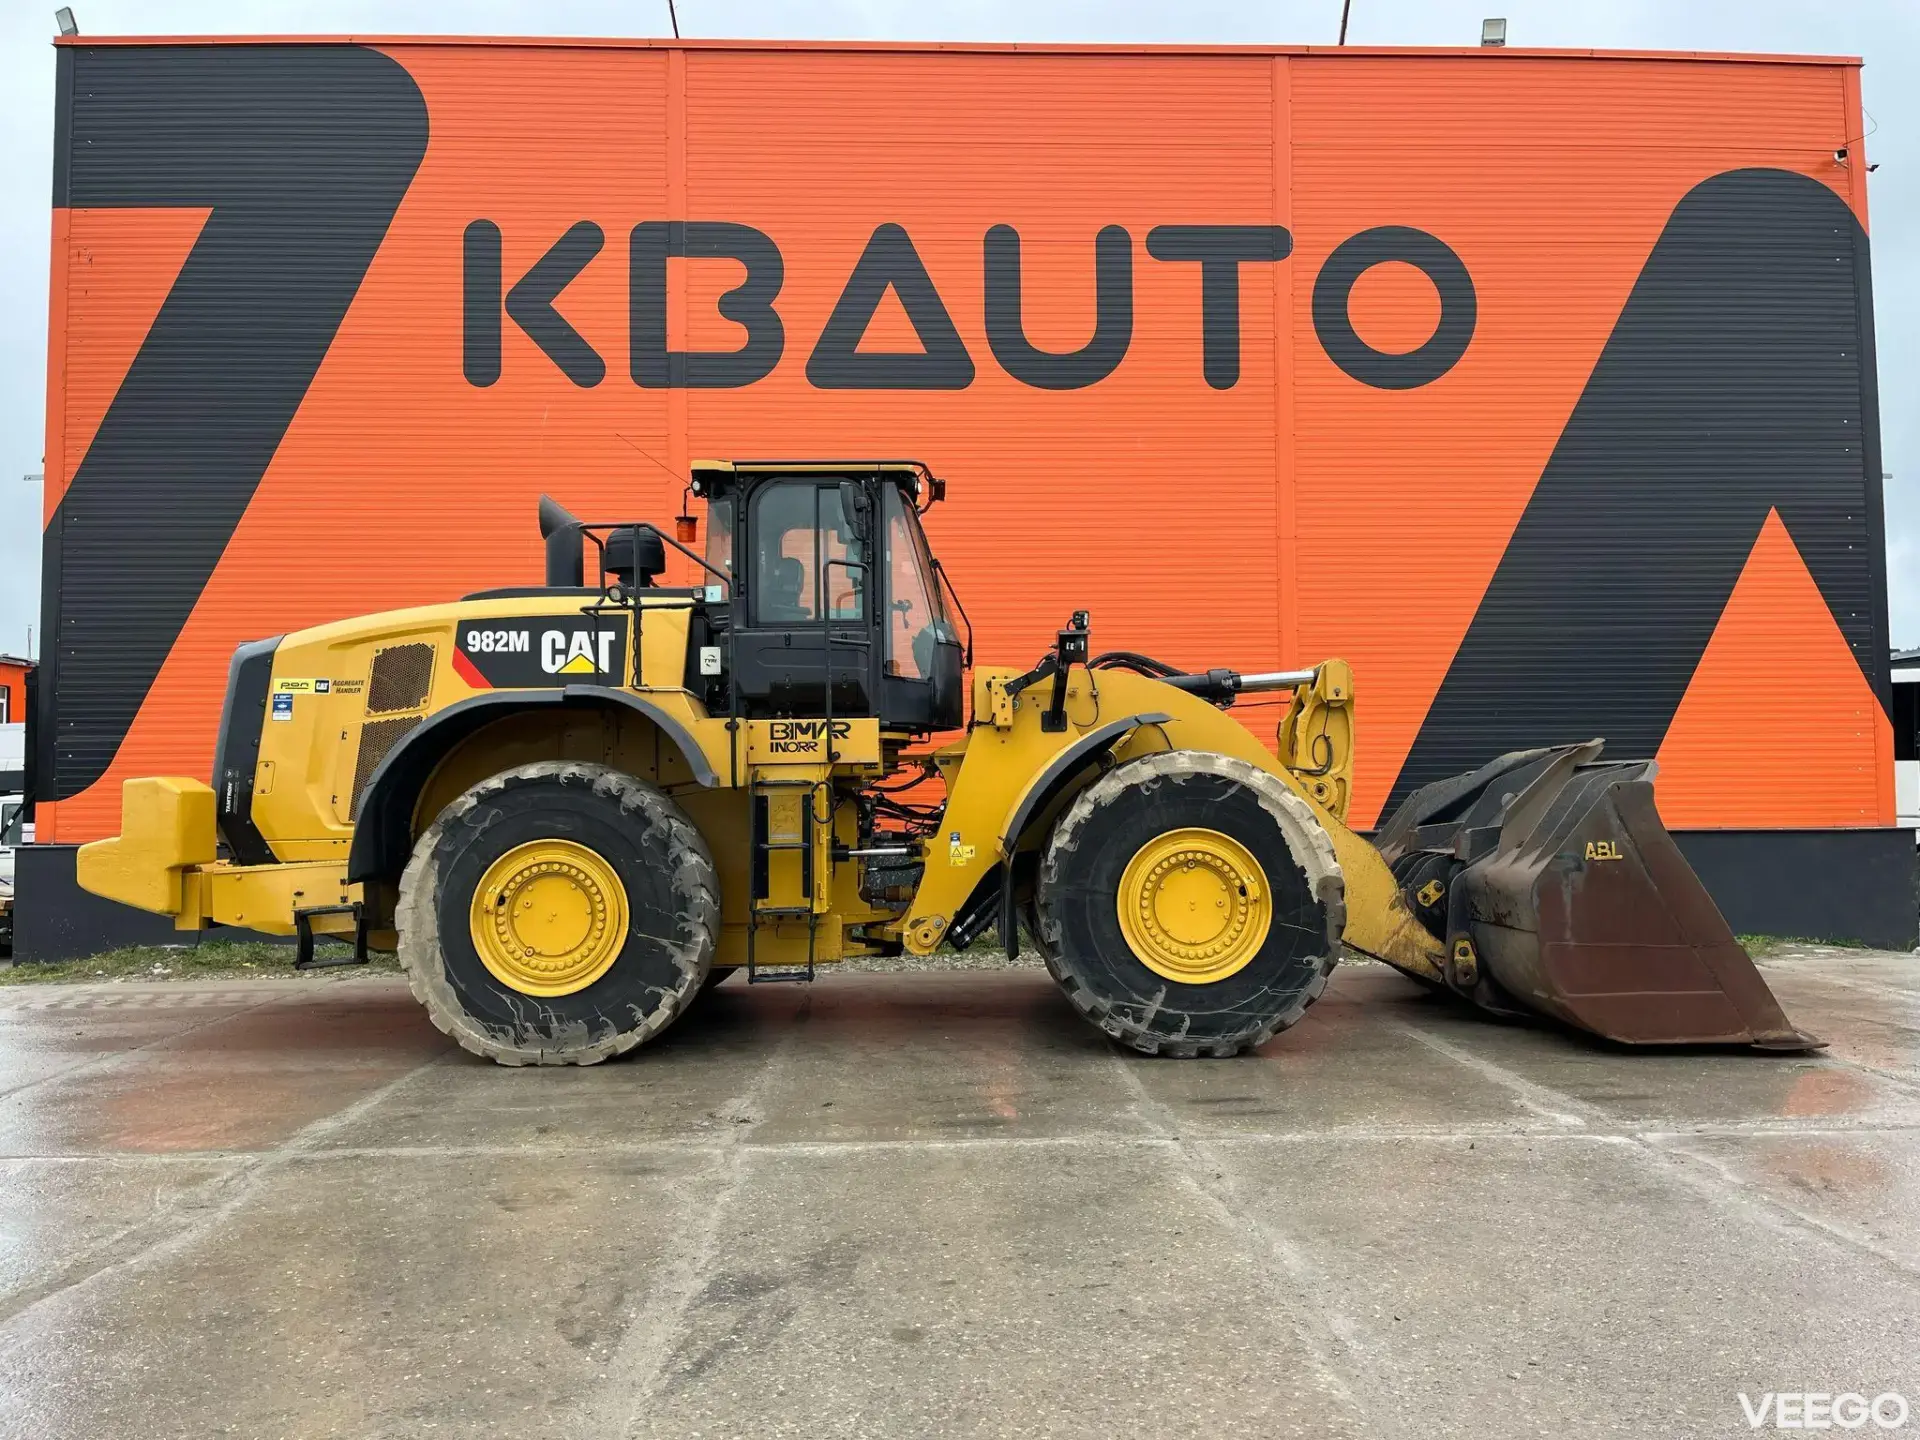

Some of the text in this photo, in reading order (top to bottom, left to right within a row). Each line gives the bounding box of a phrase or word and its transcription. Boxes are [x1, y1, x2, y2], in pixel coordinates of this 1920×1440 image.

[463, 219, 1477, 390] KBAUTO
[466, 629, 616, 674] 982M CAT
[769, 721, 852, 740] BIMAR
[769, 741, 818, 753] INORR
[1585, 841, 1623, 860] ABL
